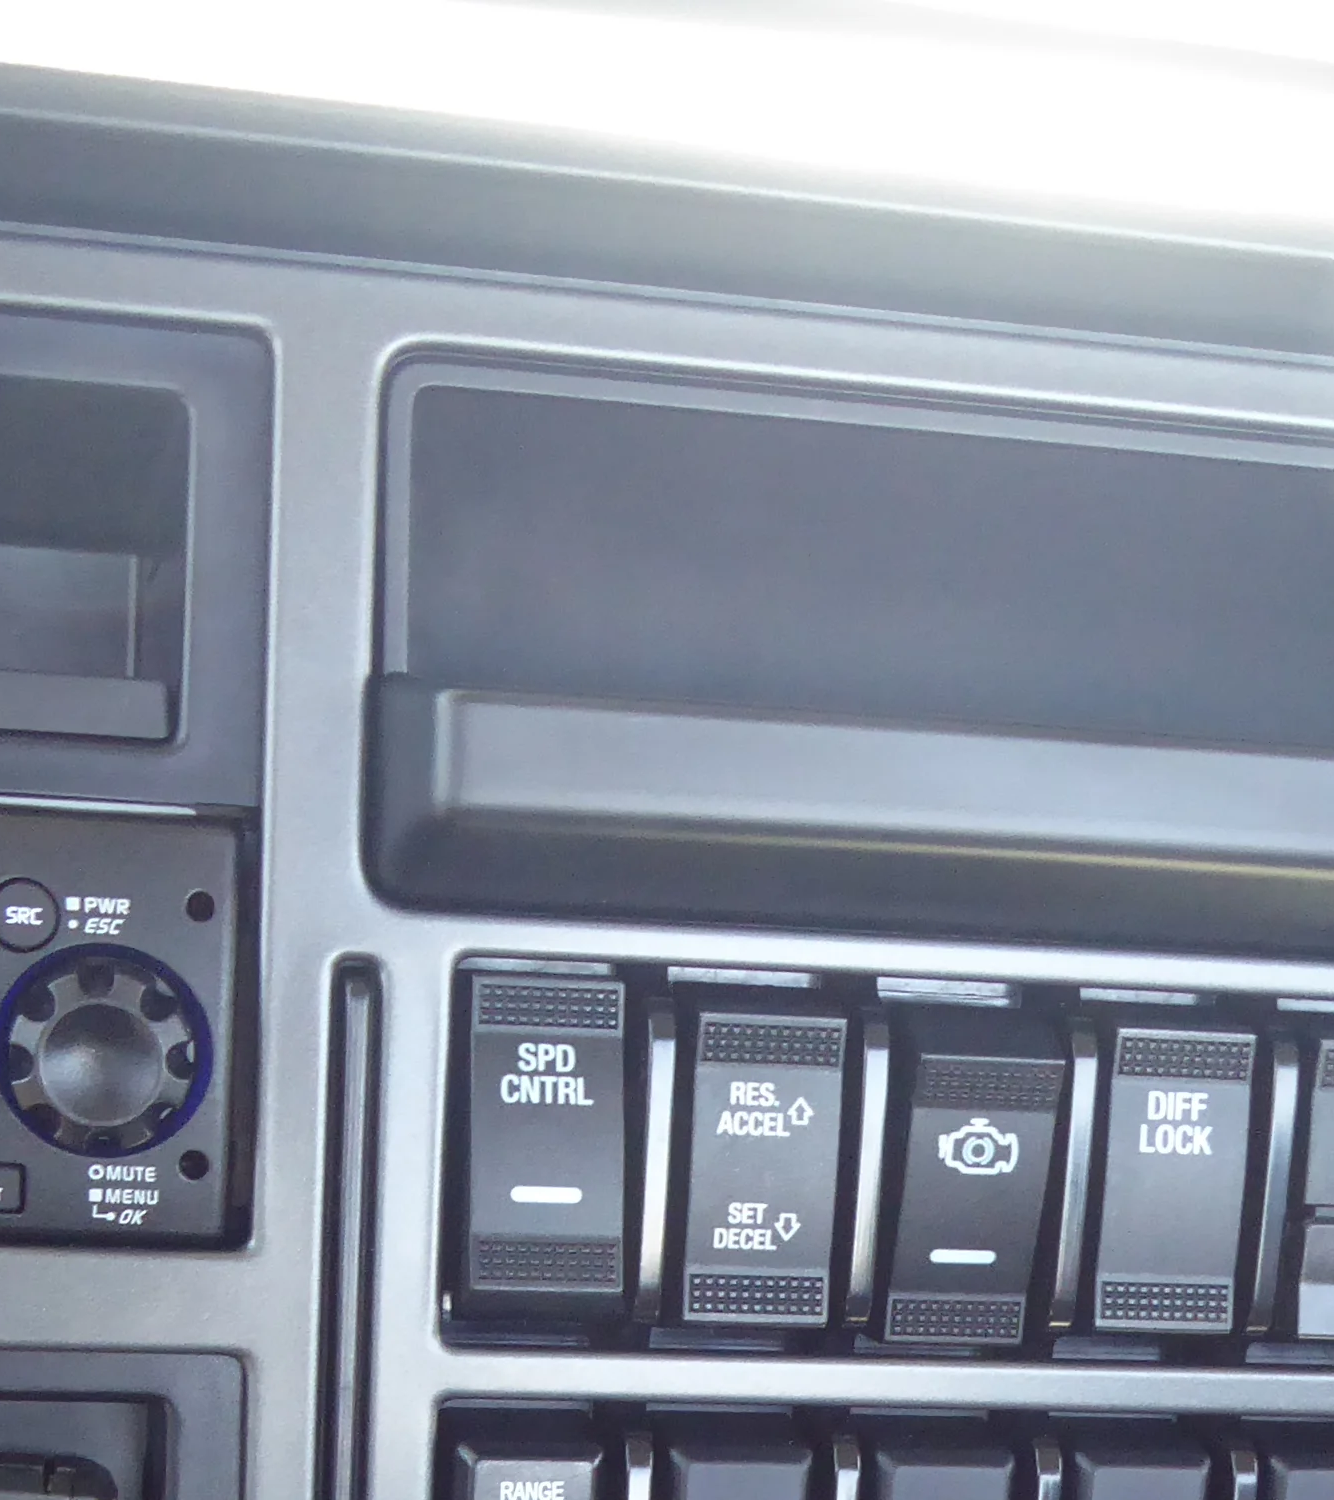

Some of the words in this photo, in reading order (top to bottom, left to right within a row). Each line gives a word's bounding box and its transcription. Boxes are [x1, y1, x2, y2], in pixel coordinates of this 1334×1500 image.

[5, 905, 43, 926] SRC
[84, 896, 130, 916] PWR
[84, 918, 124, 935] ESC
[517, 1043, 576, 1072] SPD
[500, 1074, 594, 1106] CNTRL
[729, 1082, 781, 1107] RES.
[1147, 1090, 1208, 1121] DIFF
[716, 1111, 790, 1137] ACCEL
[1138, 1124, 1213, 1156] LOCK
[106, 1165, 156, 1182] MUTE
[105, 1188, 158, 1205] MENU
[119, 1209, 146, 1225] OK
[727, 1203, 767, 1226] SET
[713, 1227, 777, 1251] DECEL
